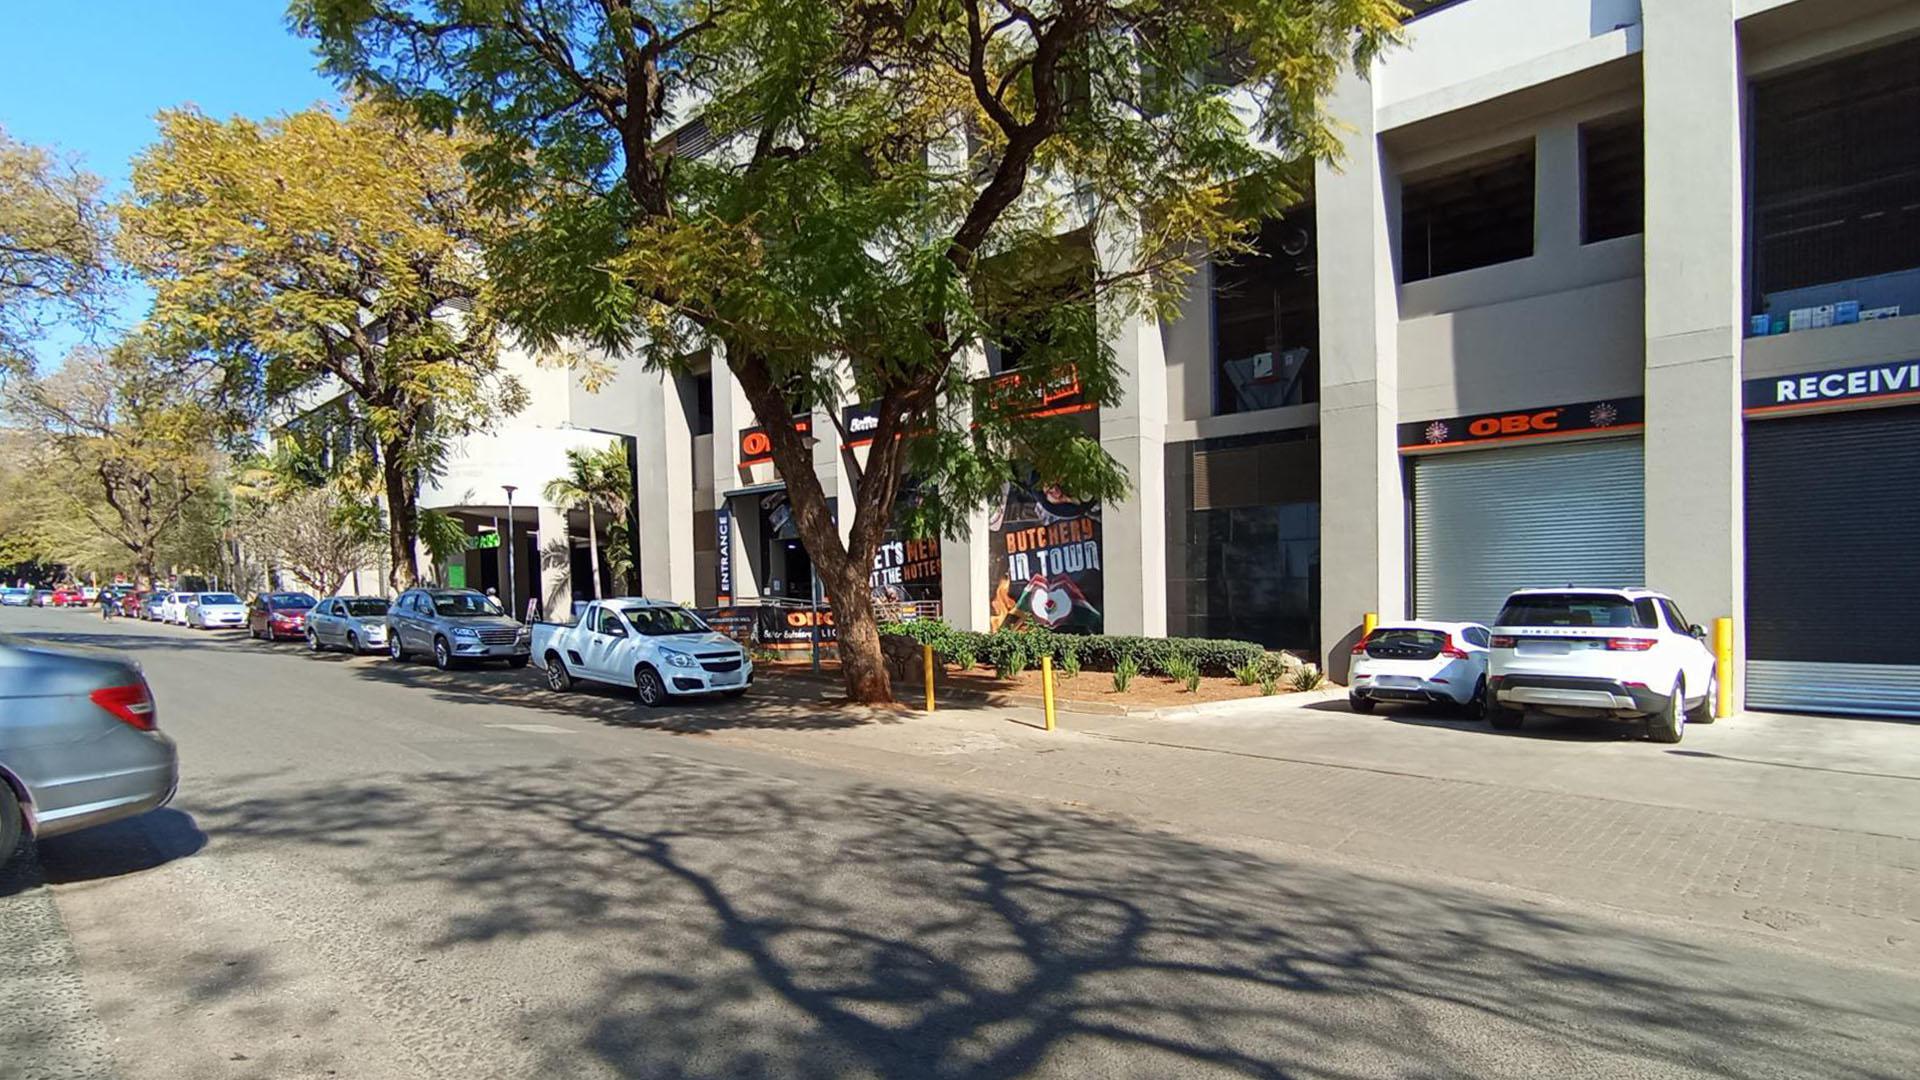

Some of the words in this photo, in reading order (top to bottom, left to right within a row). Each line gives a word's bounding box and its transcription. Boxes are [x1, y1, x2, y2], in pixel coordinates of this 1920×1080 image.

[1469, 411, 1558, 436] OBC
[1006, 518, 1093, 553] BUTCHERY
[719, 516, 730, 592] ENTRANCE
[874, 541, 904, 569] ET'S
[1008, 553, 1030, 581] IN
[1037, 541, 1100, 577] TOWN
[881, 566, 902, 586] THE
